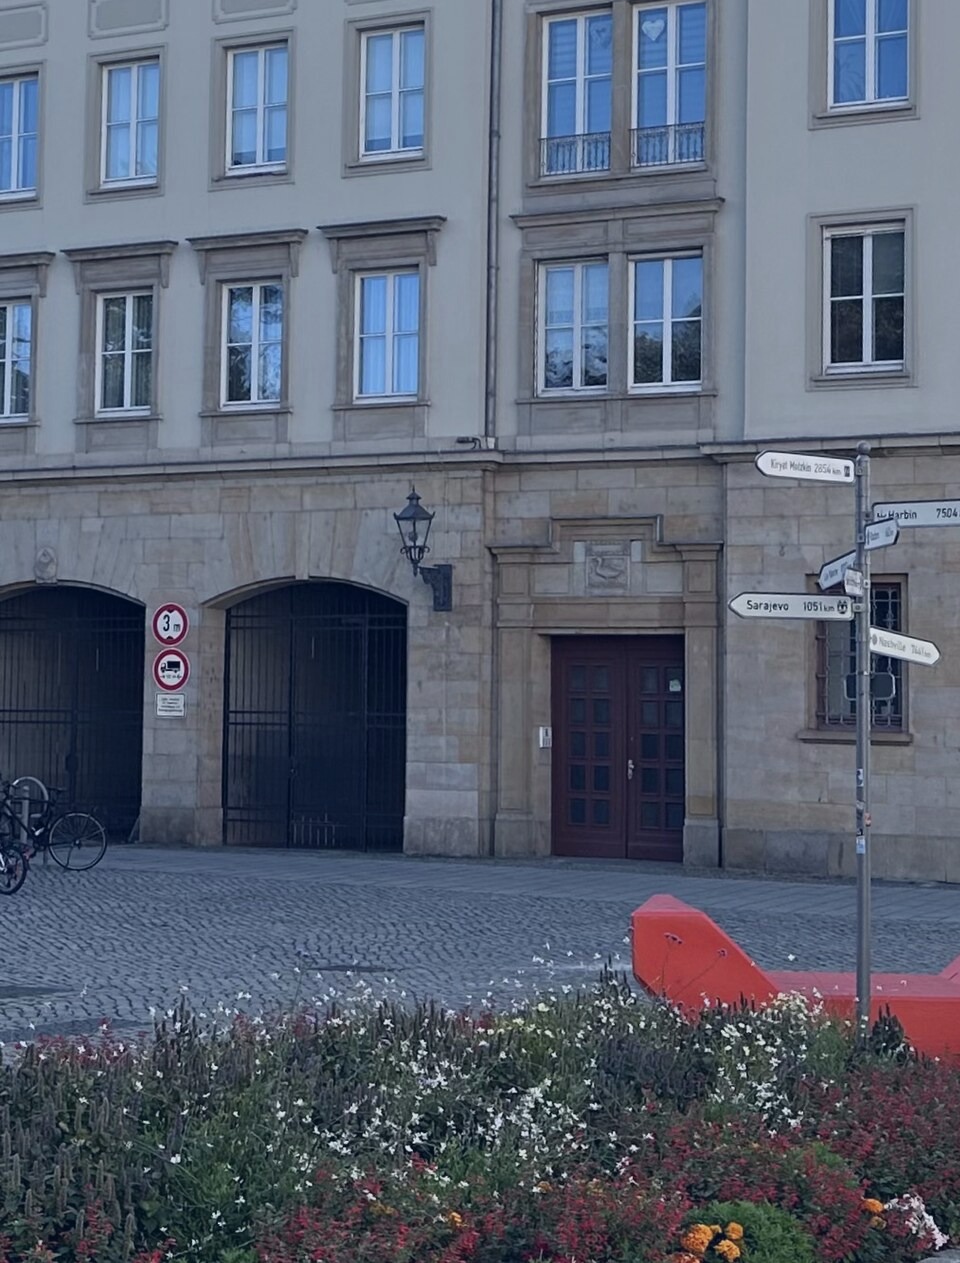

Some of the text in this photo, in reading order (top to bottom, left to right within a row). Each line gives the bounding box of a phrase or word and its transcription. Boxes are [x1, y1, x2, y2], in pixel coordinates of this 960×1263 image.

[888, 509, 917, 520] Harbin
[936, 508, 958, 518] 7504
[746, 600, 789, 613] Sarajevo
[803, 601, 823, 612] 1051
[163, 614, 181, 632] 3 m
